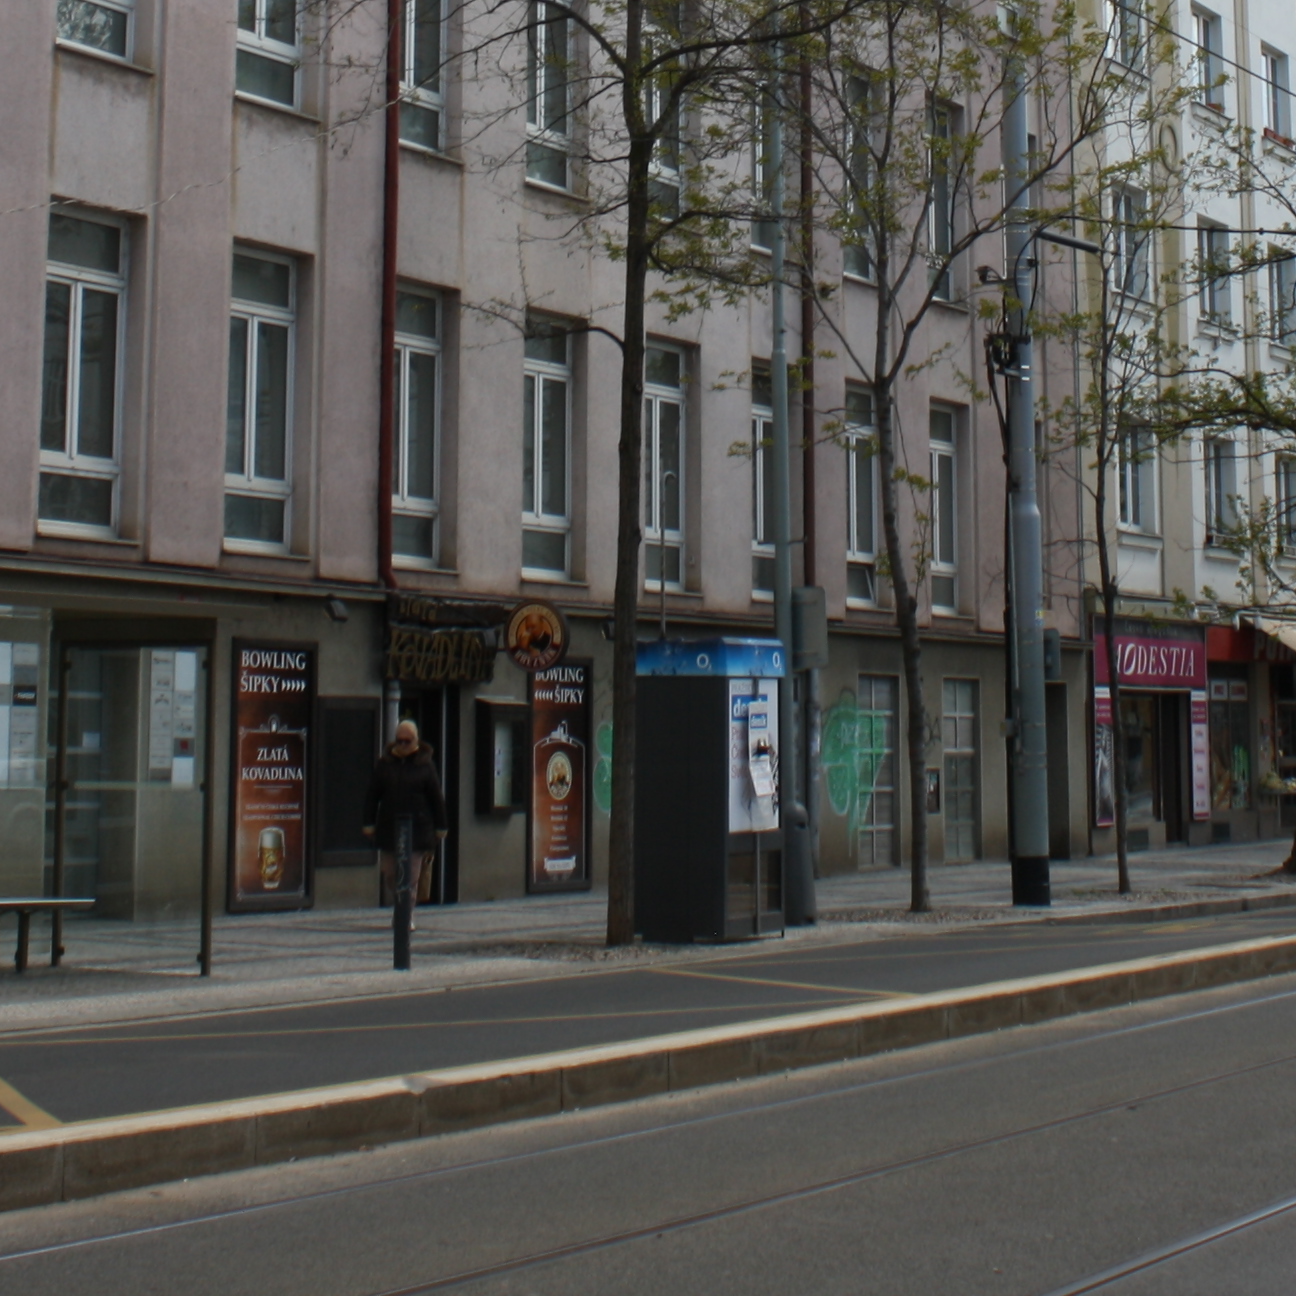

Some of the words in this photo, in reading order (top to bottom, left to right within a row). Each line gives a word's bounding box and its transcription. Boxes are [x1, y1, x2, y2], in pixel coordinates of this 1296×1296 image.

[241, 649, 306, 670] BOWLING
[240, 670, 280, 693] ŠIPKY
[535, 667, 584, 683] BOWLING
[554, 684, 584, 704] ŠIPKY
[257, 744, 289, 761] ZLATÁ
[242, 767, 303, 781] KOVADLINA
